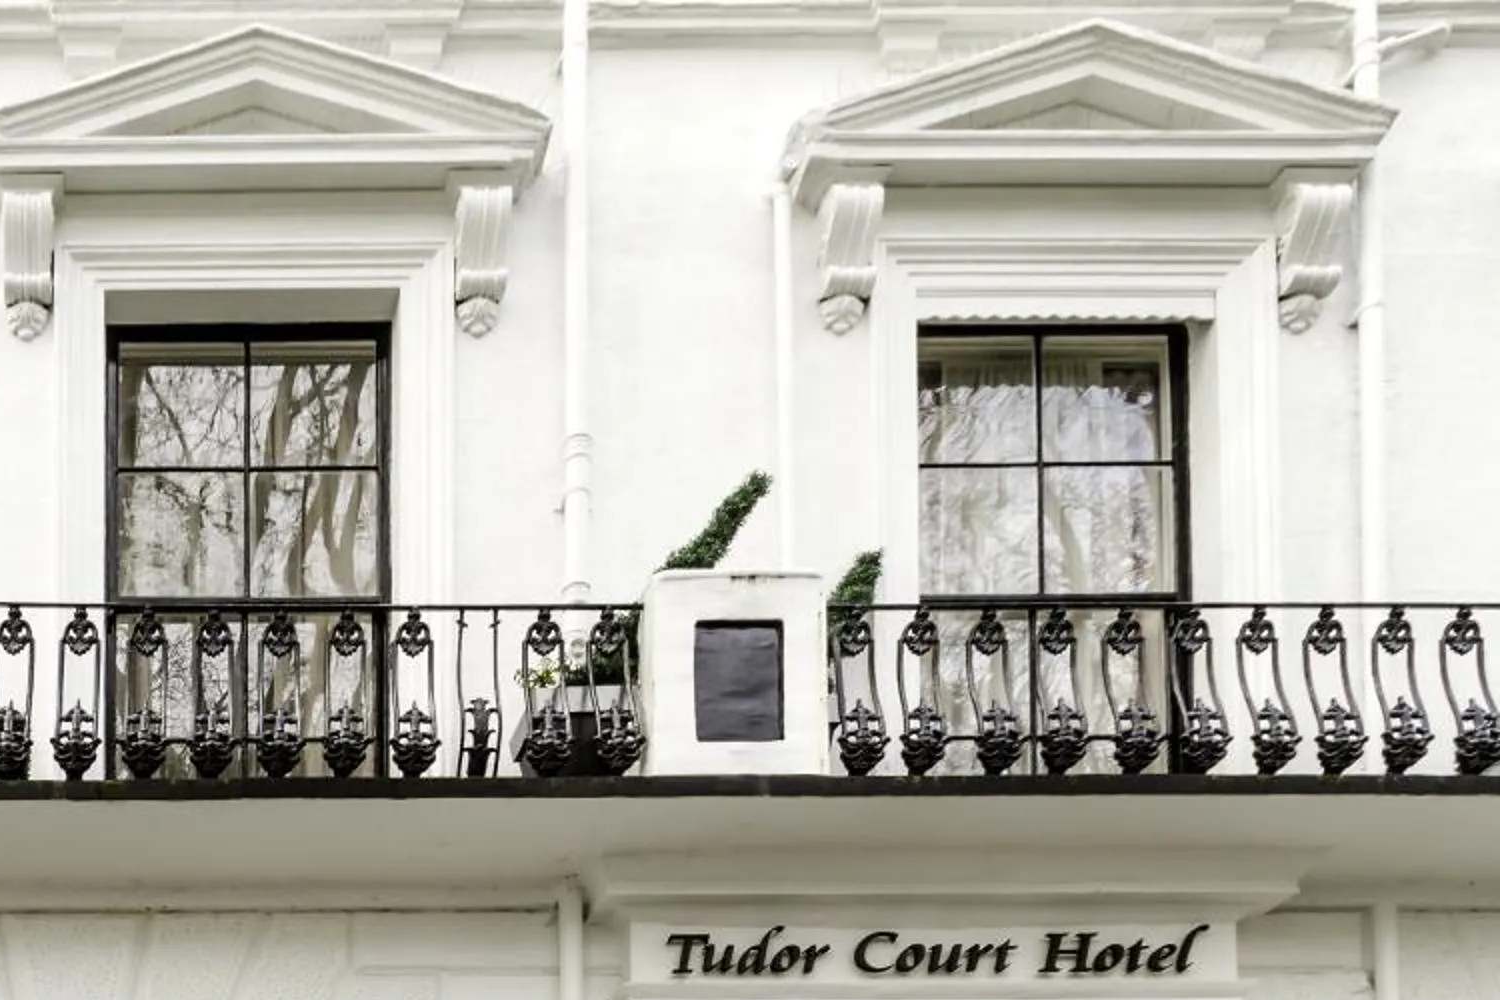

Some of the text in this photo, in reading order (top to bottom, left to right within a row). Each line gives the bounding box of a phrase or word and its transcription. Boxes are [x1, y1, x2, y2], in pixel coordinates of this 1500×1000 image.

[666, 923, 1211, 975] Tudor Court Hotel
